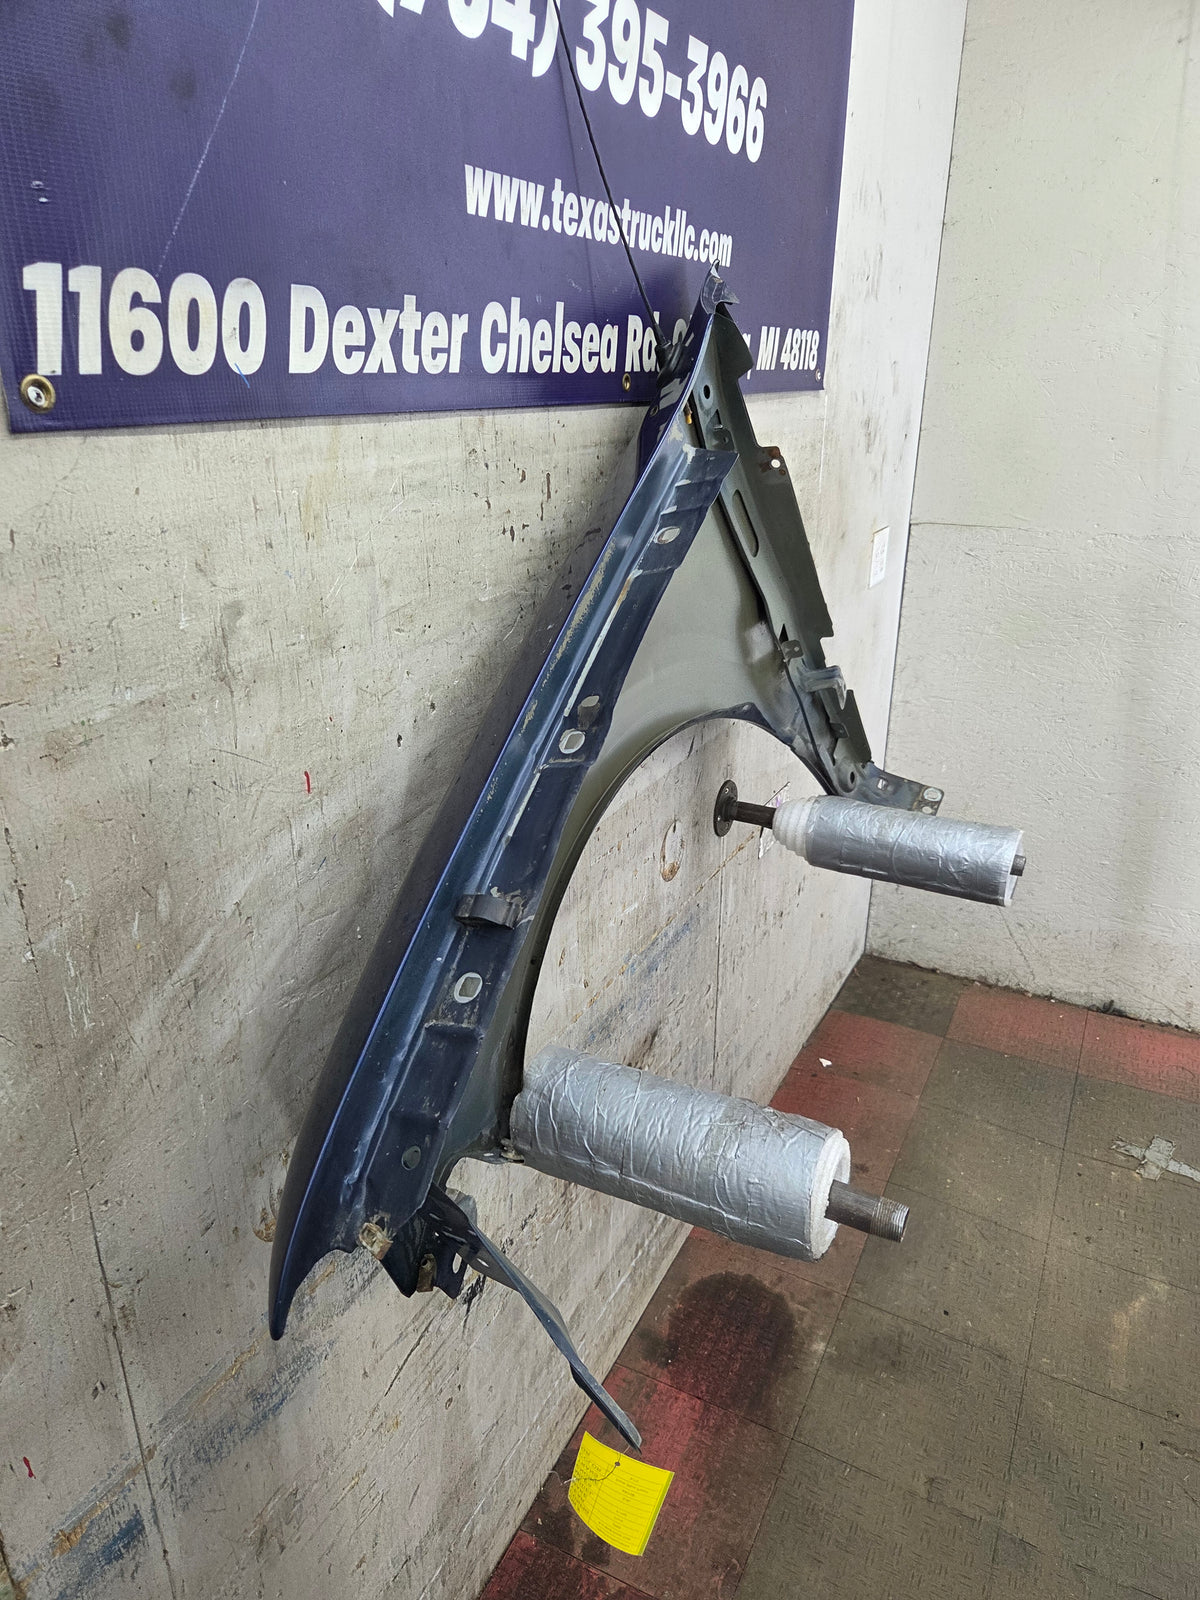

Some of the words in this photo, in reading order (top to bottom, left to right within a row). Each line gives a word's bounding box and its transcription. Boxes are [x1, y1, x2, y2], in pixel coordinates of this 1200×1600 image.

[576, 0, 767, 163] 395-3966
[464, 164, 733, 267] www.texastruckllc.com
[22, 261, 267, 376] 11600
[288, 283, 469, 375] Dexter
[480, 297, 619, 374] Chelsea
[756, 325, 780, 371] MI
[780, 328, 820, 371] 48118
